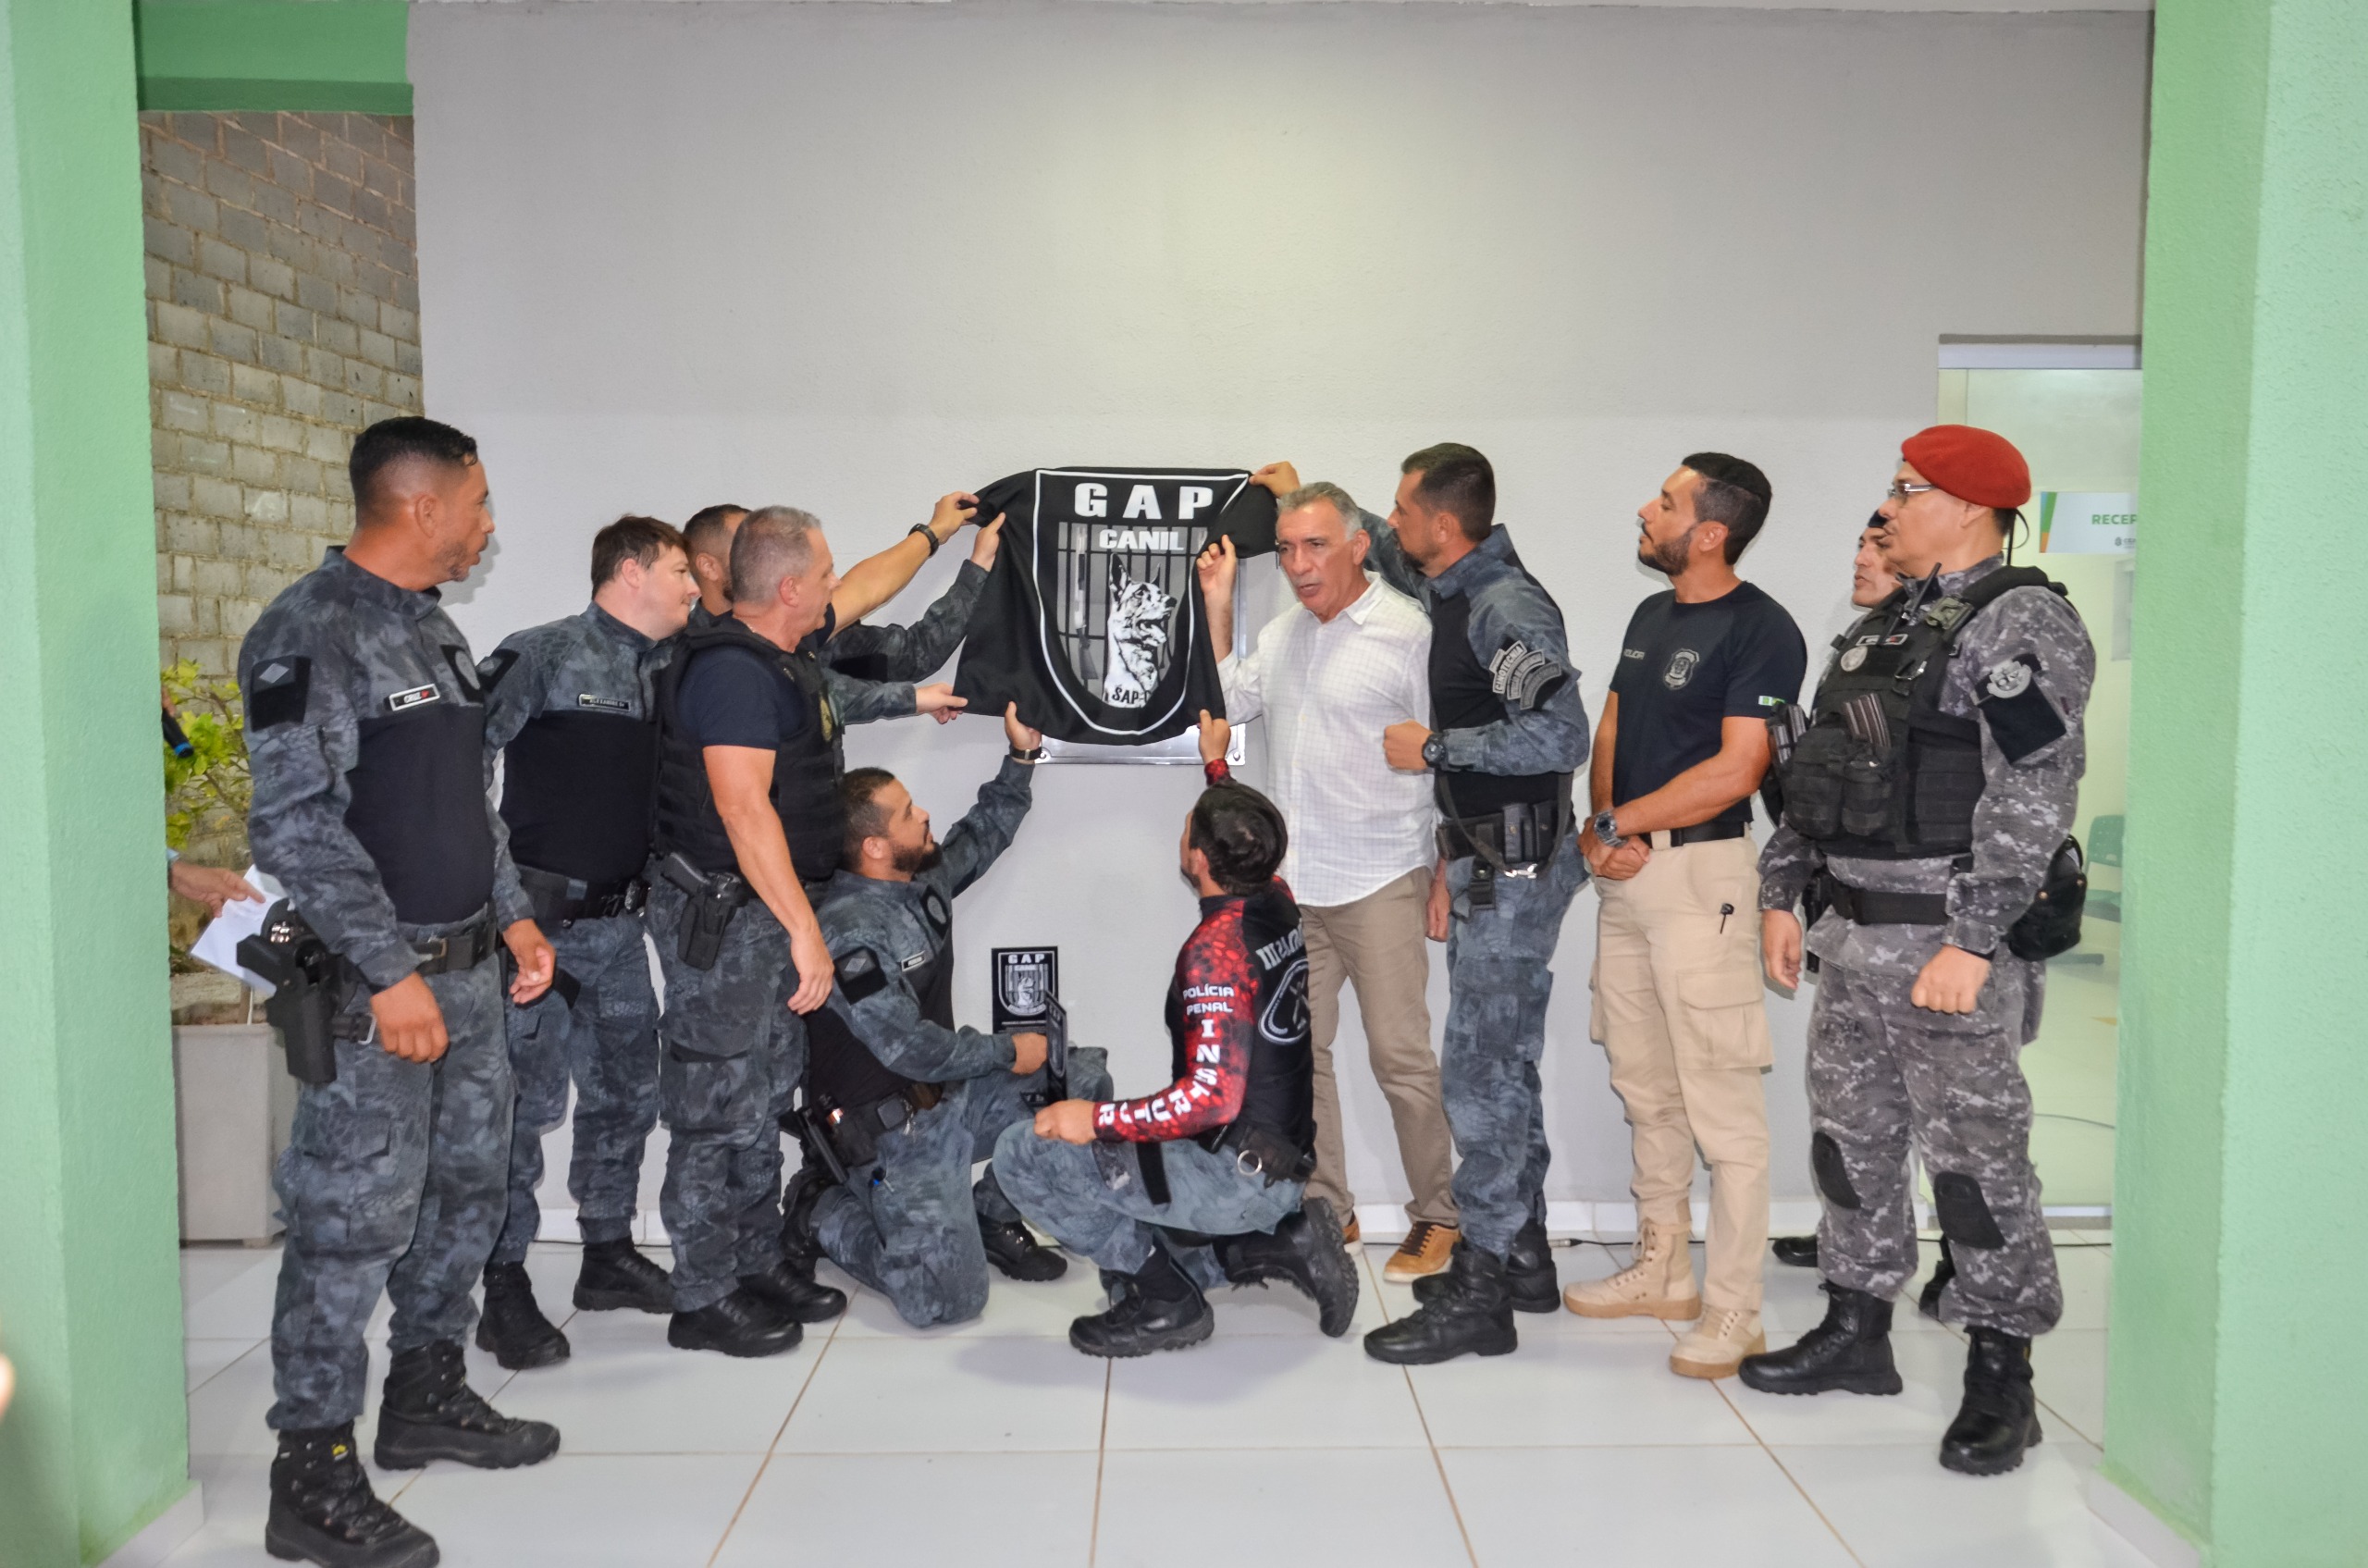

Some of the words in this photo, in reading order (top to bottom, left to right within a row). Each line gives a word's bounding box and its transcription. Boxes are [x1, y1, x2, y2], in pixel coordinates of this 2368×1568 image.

[1074, 482, 1214, 520] GAP
[1099, 529, 1184, 550] CANIL
[1007, 953, 1045, 964] GAP
[1183, 982, 1235, 1000] POLÍCIA
[1186, 1001, 1234, 1016] PENAL
